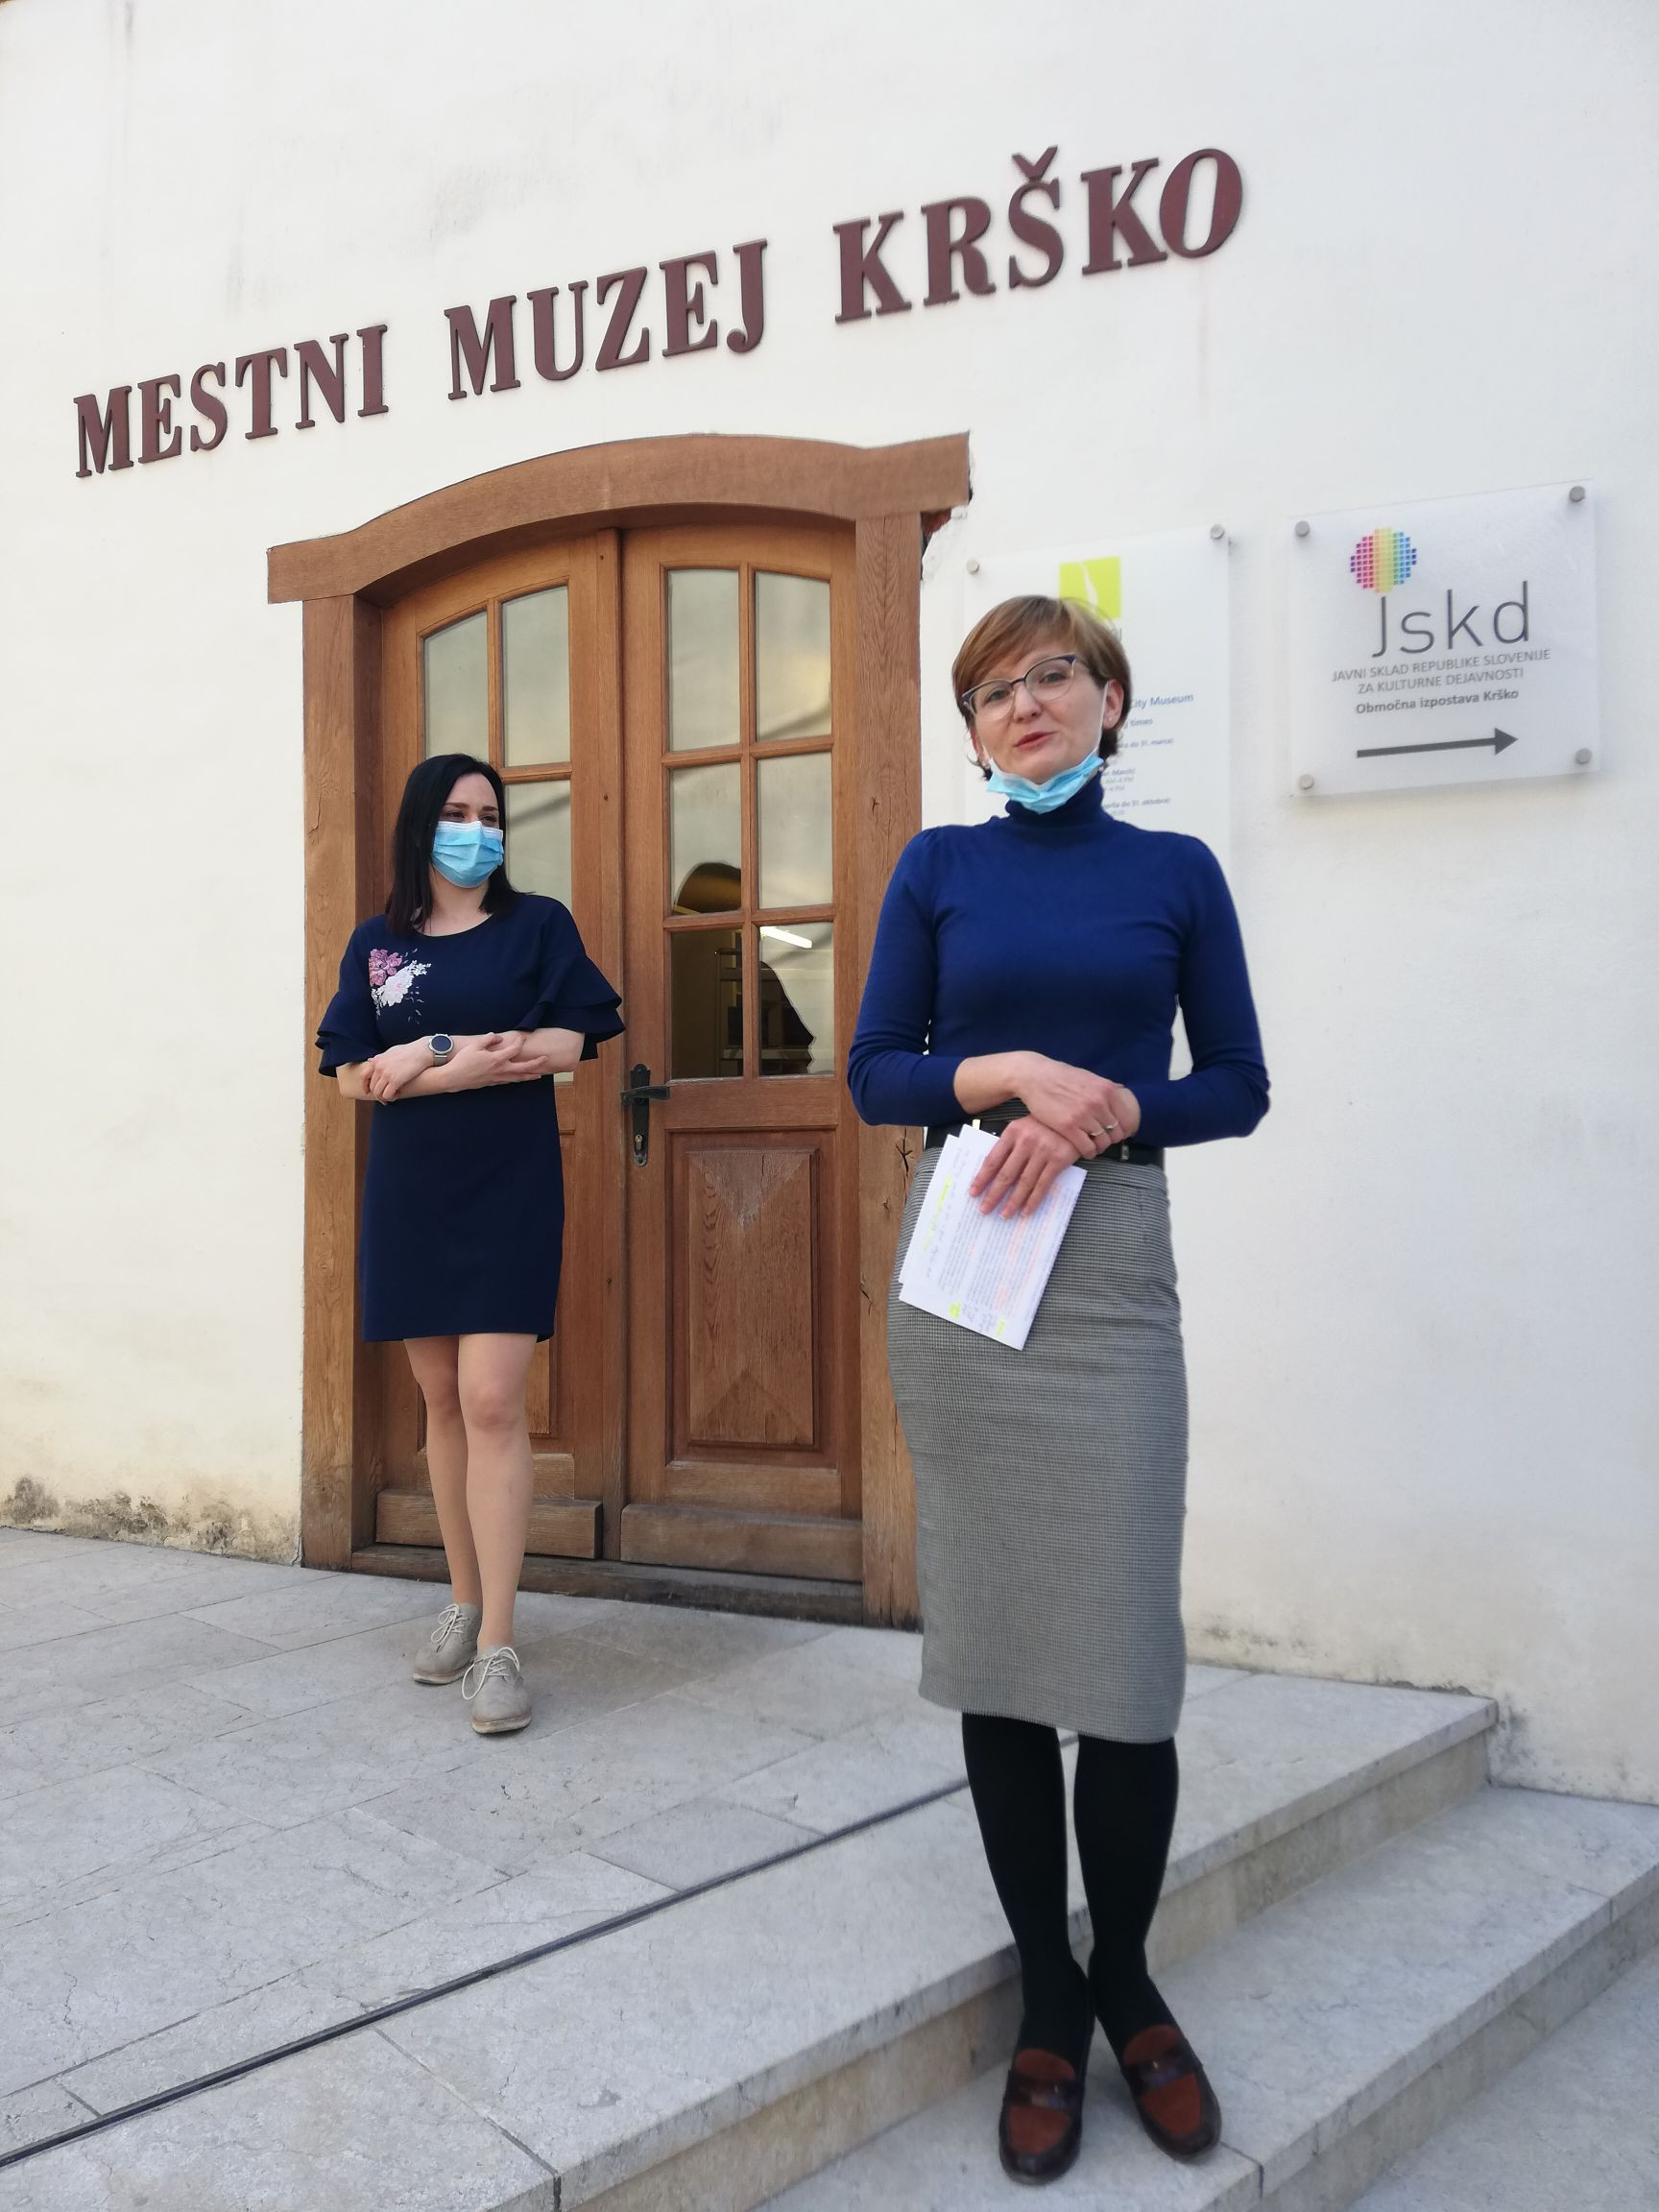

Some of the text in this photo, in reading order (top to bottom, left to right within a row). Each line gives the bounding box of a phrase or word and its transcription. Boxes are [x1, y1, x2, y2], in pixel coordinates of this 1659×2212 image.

[73, 145, 1243, 478] MESTNI MUZEJ KRŠKO
[1332, 649, 1551, 682] JAVNI SKLAD REPUBLIKE SLOVENIJE
[1358, 667, 1525, 695] ZA KULTURNE DEJAVNOSTI
[1150, 694, 1194, 707] Museum
[1356, 688, 1519, 715] Območna izpostava Krško
[1130, 718, 1154, 727] times
